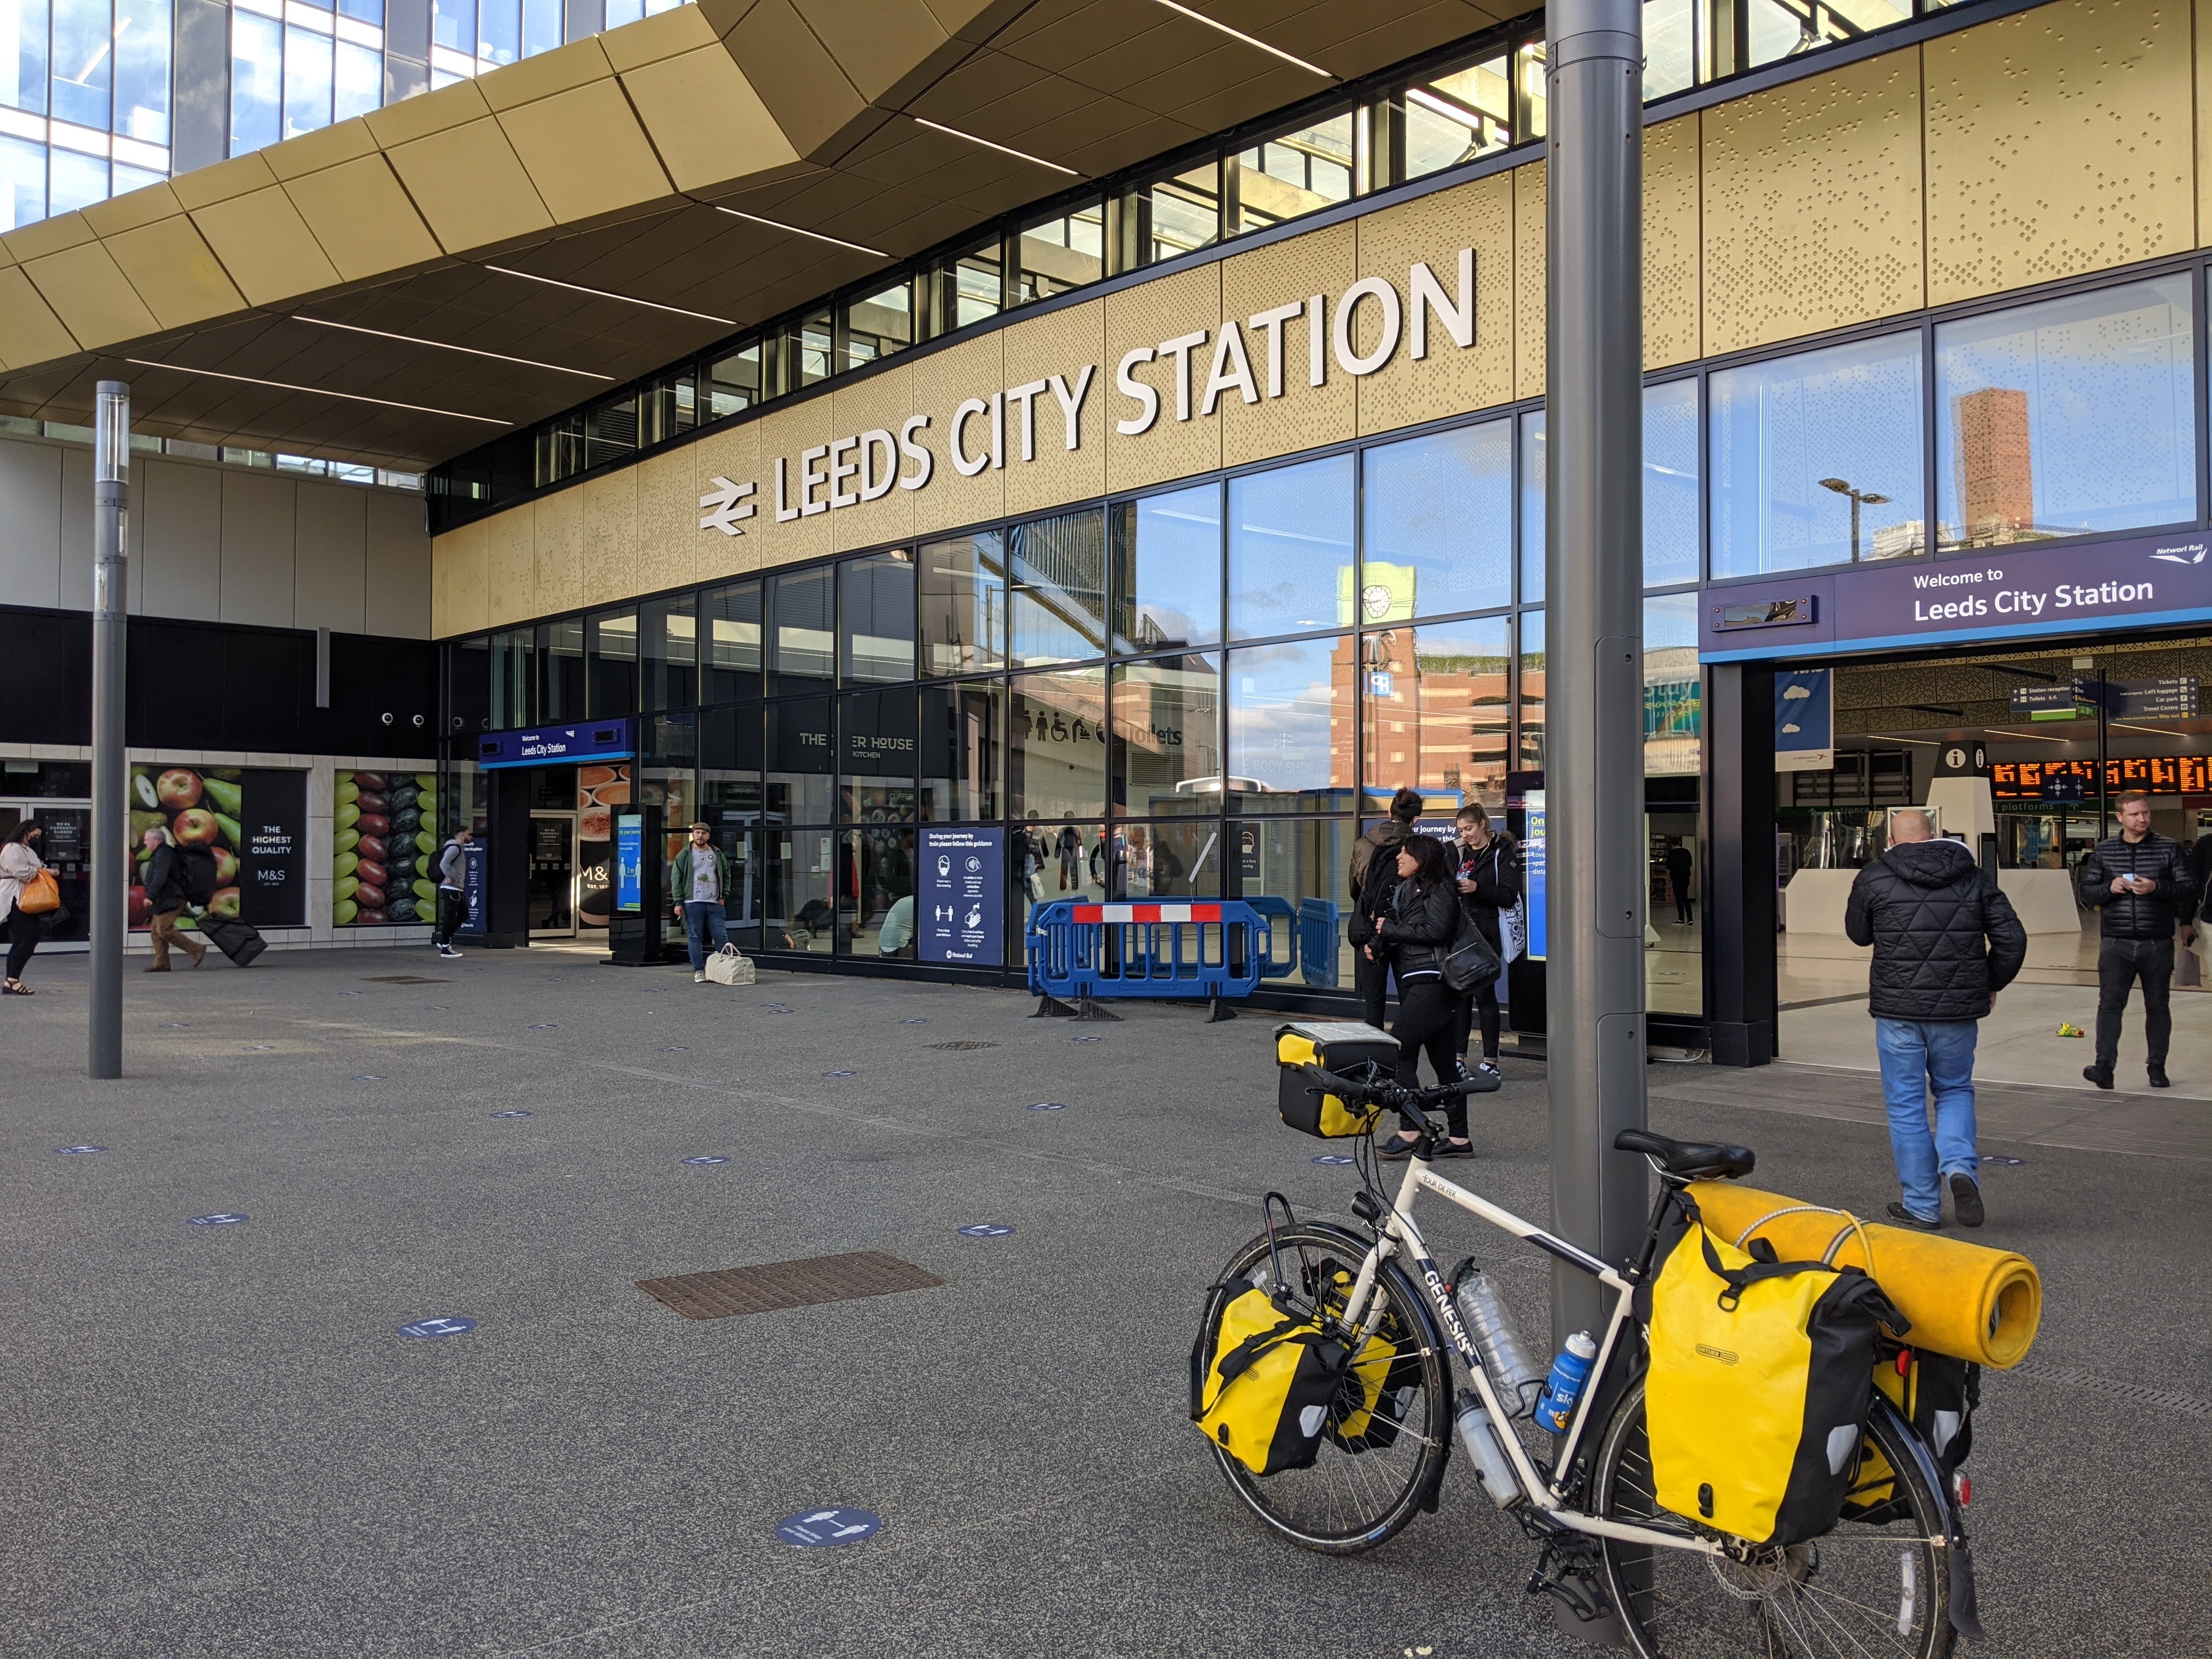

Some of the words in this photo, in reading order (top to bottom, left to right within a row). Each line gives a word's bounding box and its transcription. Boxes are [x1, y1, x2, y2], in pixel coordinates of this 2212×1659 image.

[775, 415, 934, 522] LEEDS
[950, 364, 1096, 477] CITY
[1115, 247, 1477, 437] STATION
[1914, 572, 1983, 588] Welcome
[1987, 568, 2004, 581] to
[1914, 595, 1987, 621] Leeds
[1994, 590, 2047, 616] City
[2055, 581, 2153, 607] Station
[799, 732, 827, 746] THE
[871, 737, 913, 751] HOUSE
[522, 745, 537, 756] Leeds
[537, 744, 548, 756] City
[548, 743, 566, 753] Station
[2002, 803, 2054, 812] platforms
[1531, 816, 1544, 825] On
[1447, 825, 1456, 833] by
[258, 870, 285, 881] M&S
[1438, 1183, 1446, 1193] DE
[1446, 1188, 1457, 1198] FER
[1425, 1270, 1469, 1353] GENESIS
